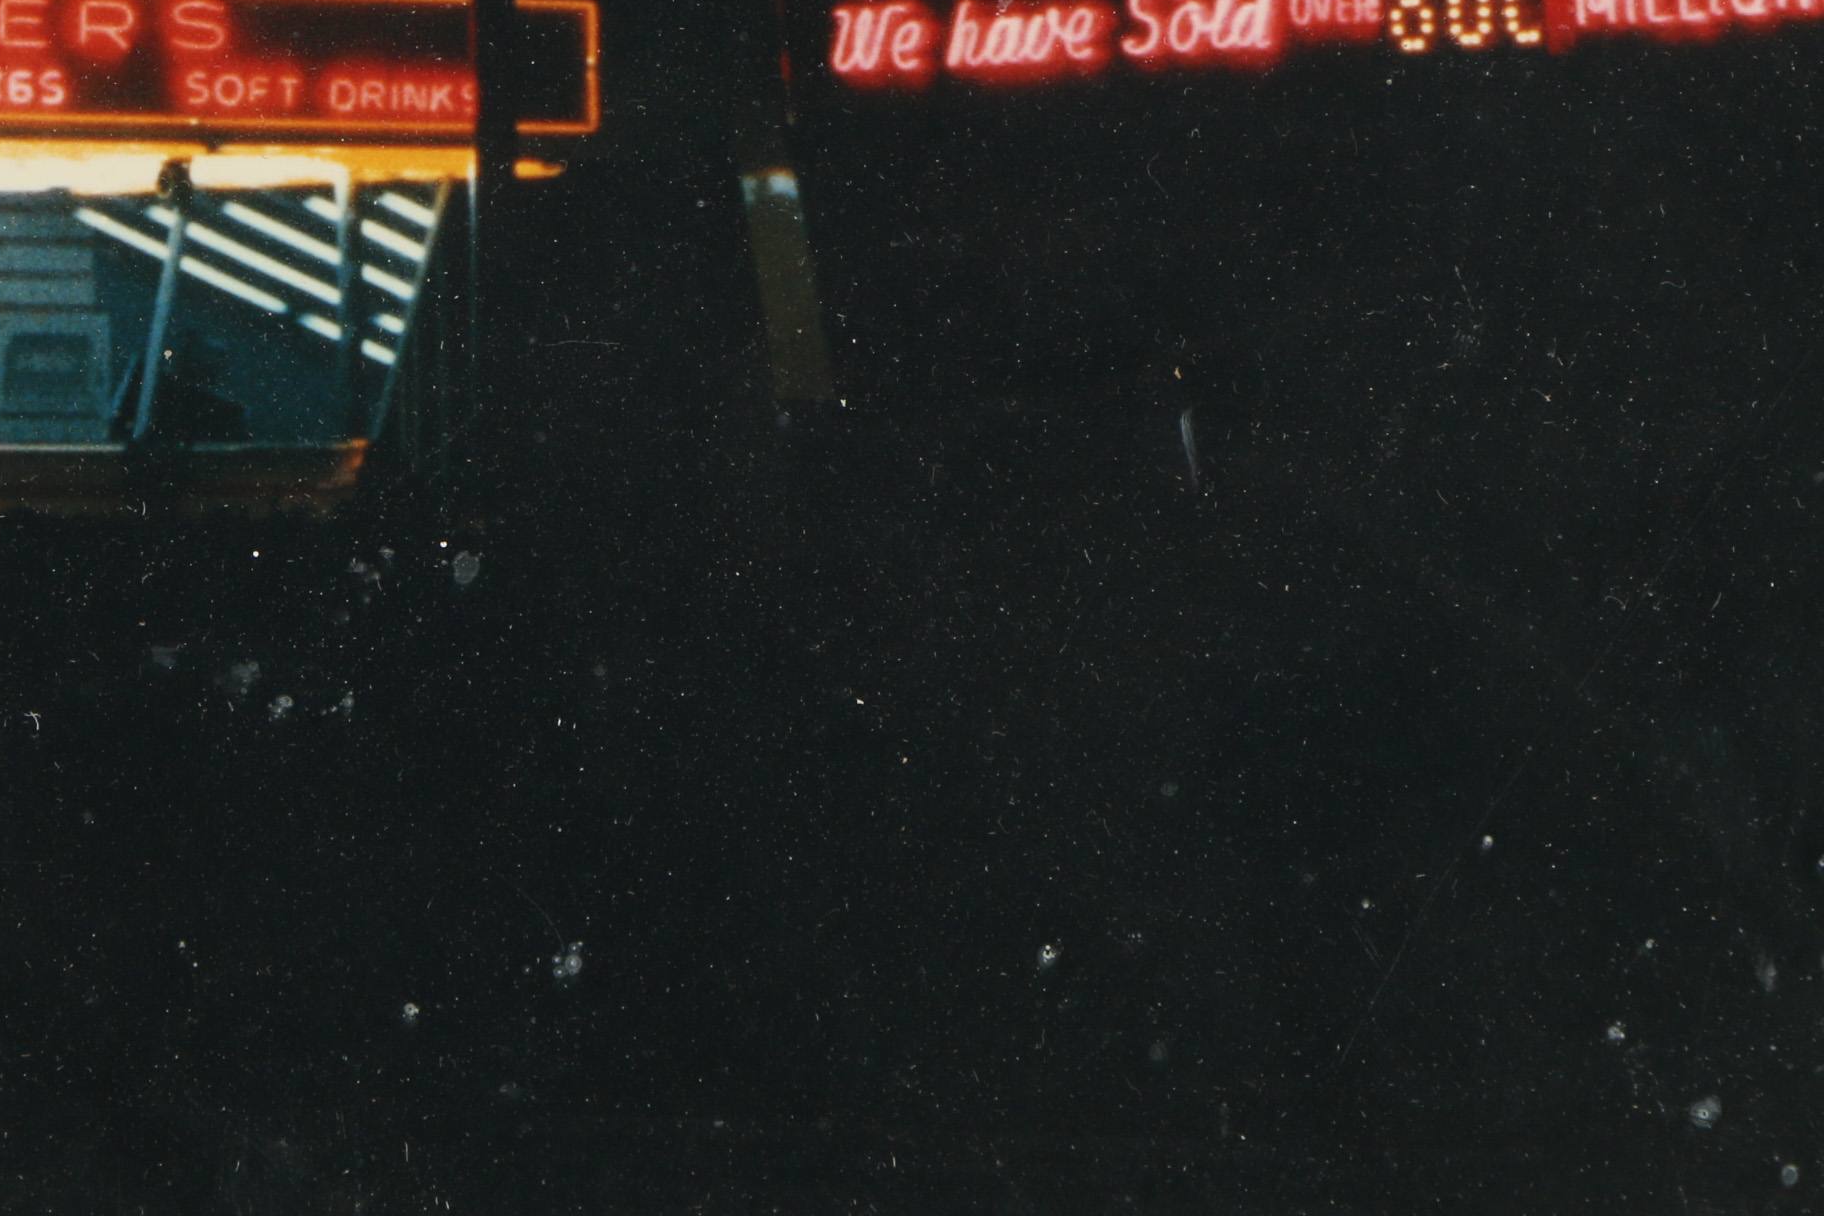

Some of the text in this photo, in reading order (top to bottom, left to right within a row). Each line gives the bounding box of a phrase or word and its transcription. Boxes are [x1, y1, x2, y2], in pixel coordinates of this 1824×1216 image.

[833, 3, 922, 72] We
[946, 0, 1095, 67] have
[185, 71, 299, 107] SOFT
